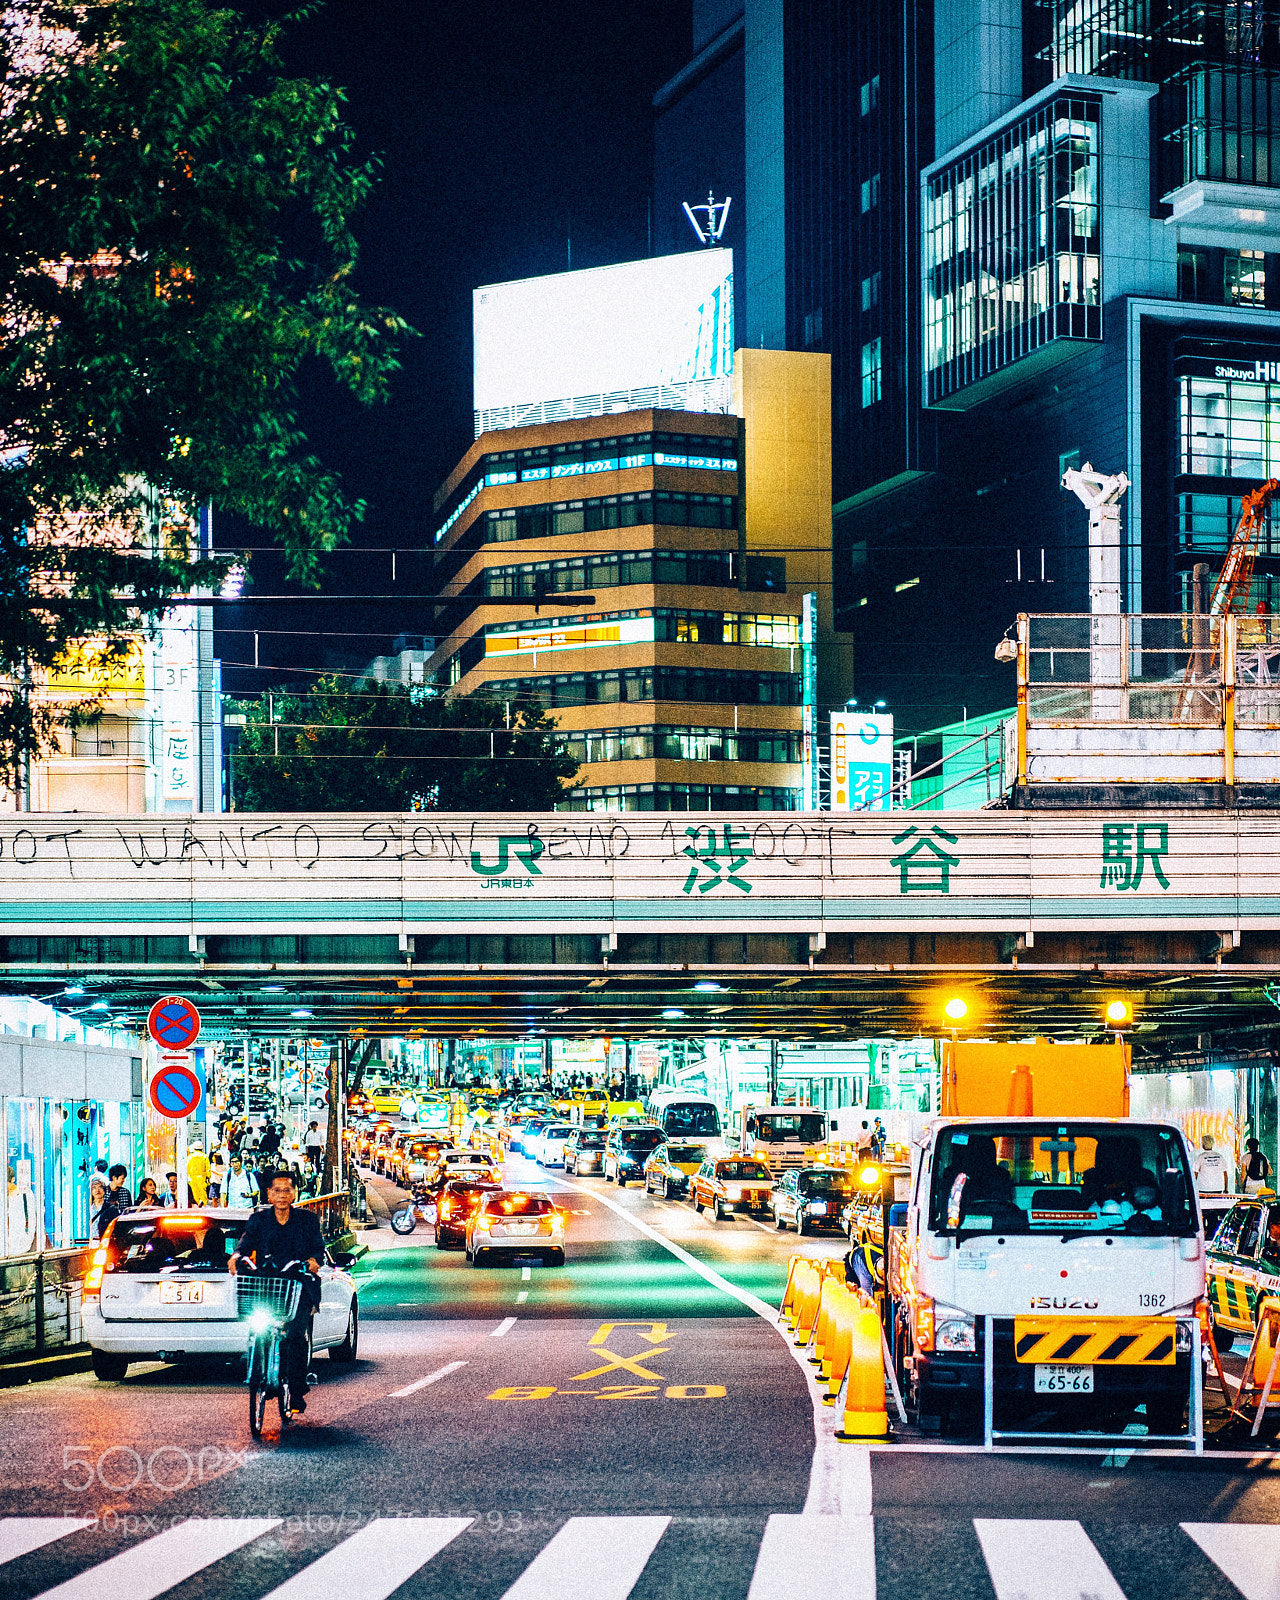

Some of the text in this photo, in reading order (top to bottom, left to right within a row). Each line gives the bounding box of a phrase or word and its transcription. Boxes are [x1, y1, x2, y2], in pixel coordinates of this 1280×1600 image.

[1215, 366, 1254, 381] Shibuya
[625, 455, 646, 467] 11F
[166, 668, 189, 685] 3F
[470, 836, 544, 875] JR
[481, 879, 535, 890] JR東日本
[165, 998, 184, 1006] 7-20
[1030, 1297, 1099, 1309] ISUZU
[1139, 1294, 1166, 1307] 1362
[1048, 1375, 1090, 1390] 65-66
[485, 1385, 727, 1400] 8-20
